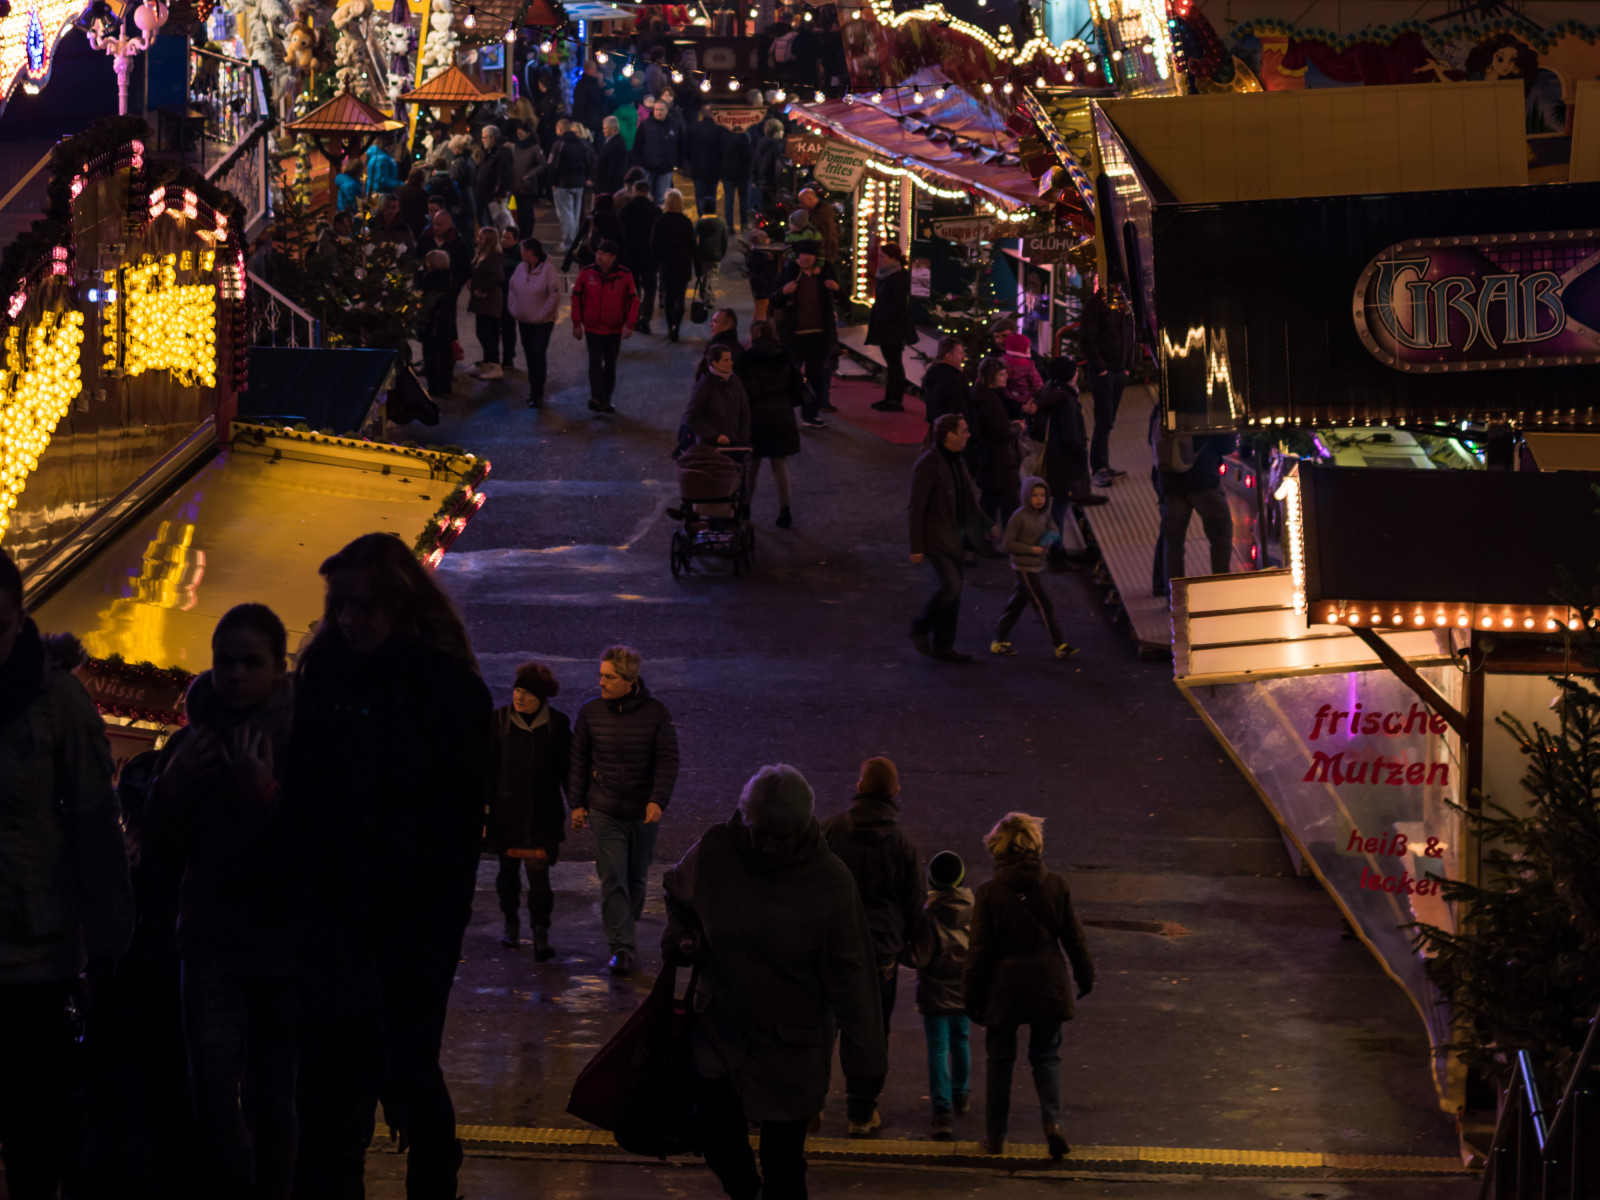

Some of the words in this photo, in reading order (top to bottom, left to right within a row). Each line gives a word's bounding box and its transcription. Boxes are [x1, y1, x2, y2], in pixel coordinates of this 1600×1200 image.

[821, 151, 864, 167] Pommes
[1376, 257, 1566, 352] GRAB
[84, 676, 146, 701] Nüsse
[1309, 702, 1448, 741] frische
[1302, 751, 1449, 786] Mutzen
[1347, 829, 1408, 857] heiß
[1425, 836, 1443, 858] &
[1360, 867, 1440, 896] lecker
